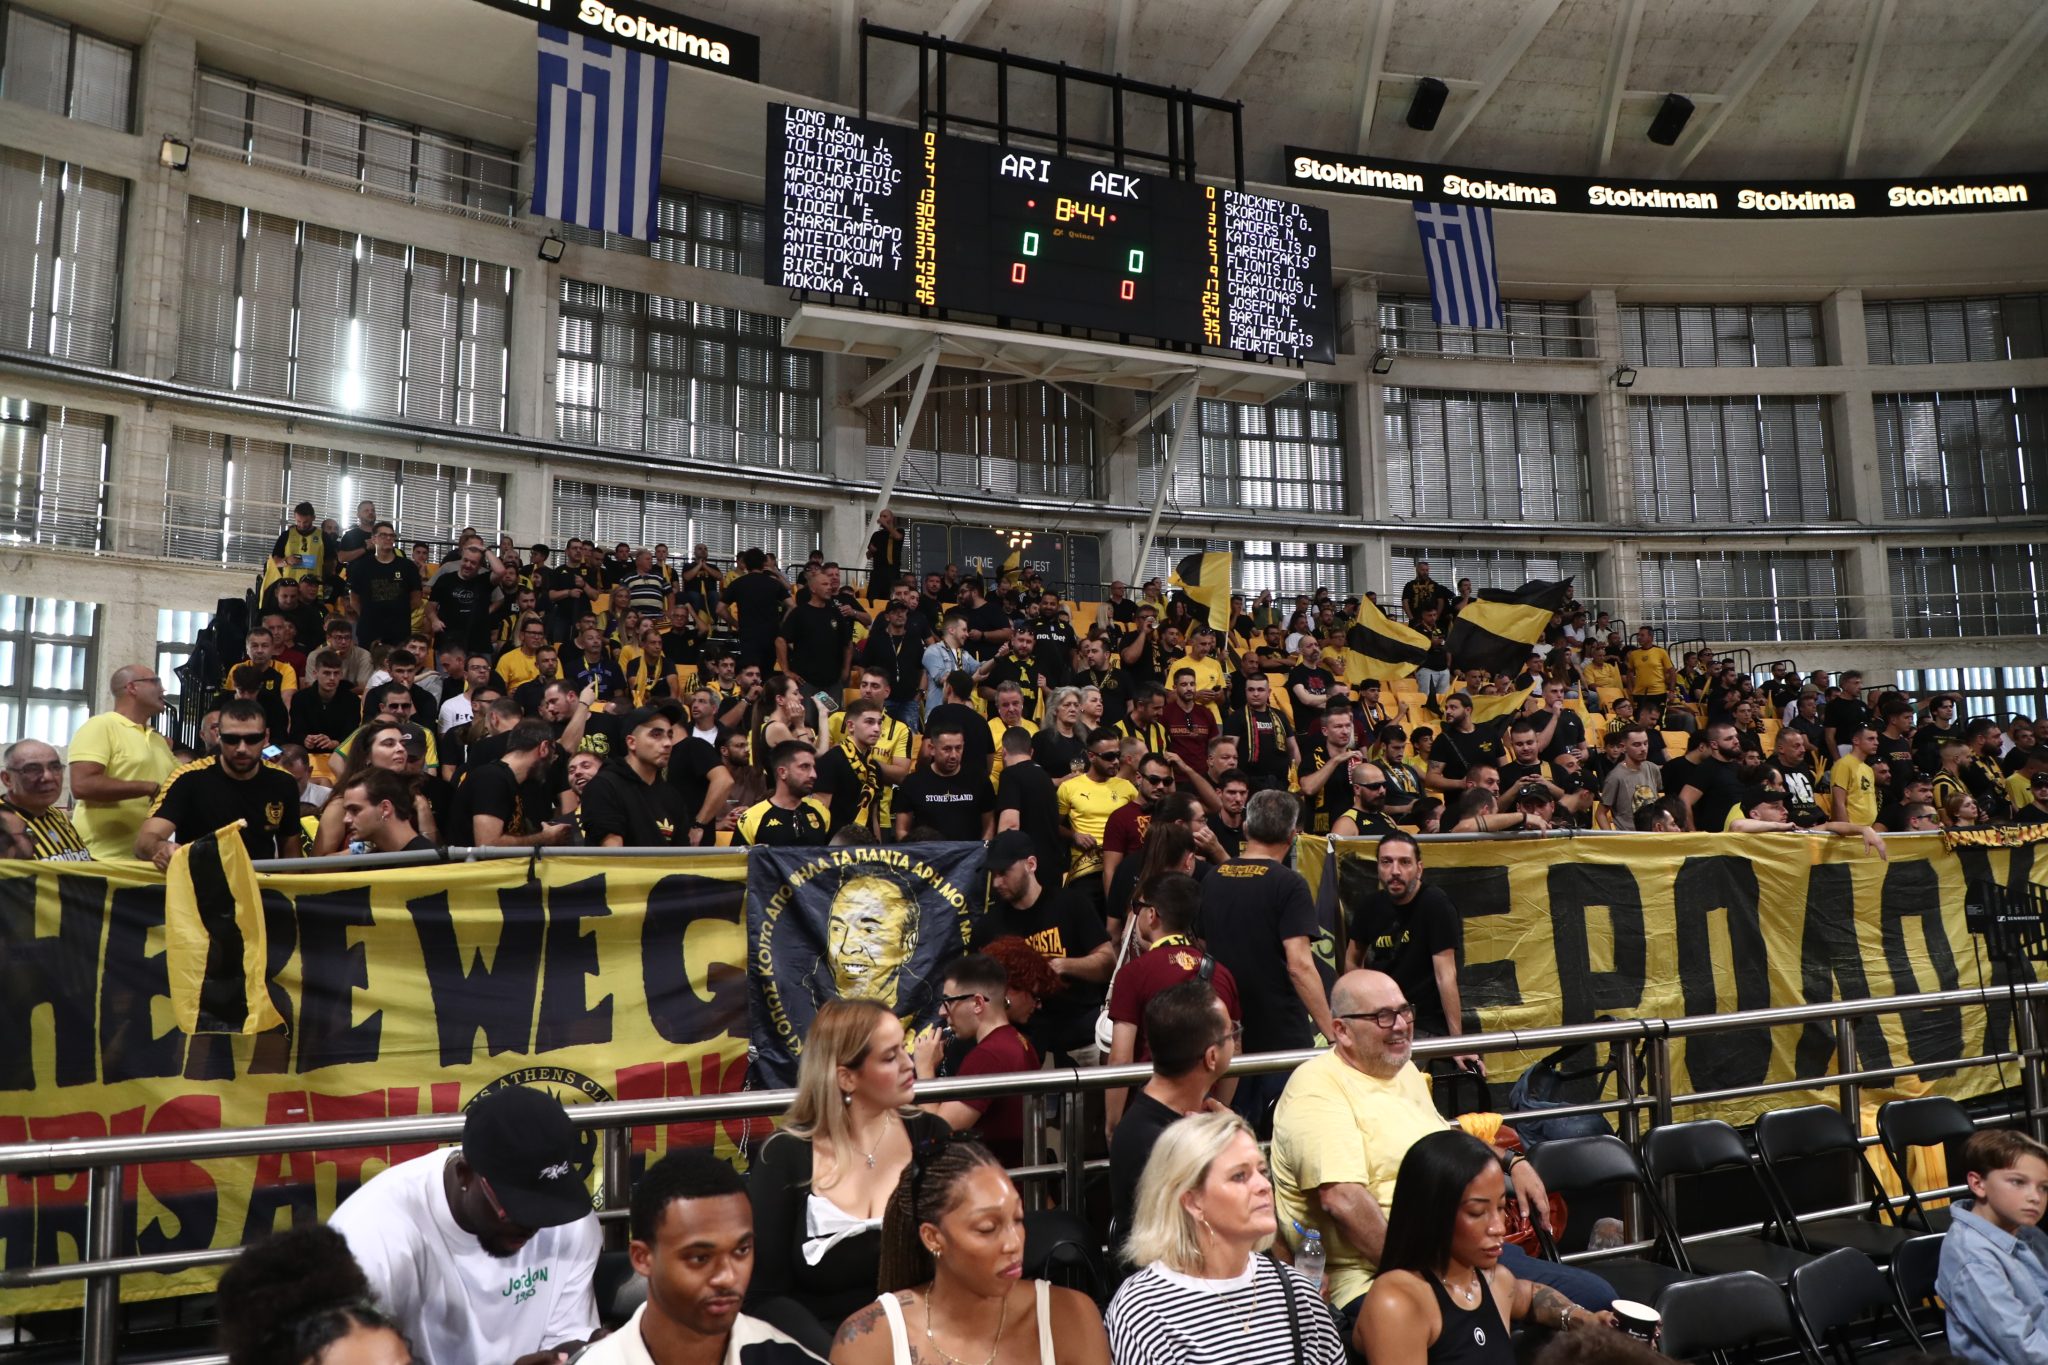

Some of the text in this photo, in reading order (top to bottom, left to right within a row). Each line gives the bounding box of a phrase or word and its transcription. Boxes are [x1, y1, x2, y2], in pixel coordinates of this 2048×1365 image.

[578, 0, 730, 65] Stoixima
[785, 107, 935, 146] LONG M. 0
[785, 122, 935, 160] ROBINSON J. 3
[784, 151, 935, 187] DIMITRIJEVIC 7
[787, 136, 935, 173] TOLIOPOULOS 4
[1001, 154, 1051, 183] ARI
[784, 167, 935, 202] MPOCHORIDIS 13
[1090, 171, 1141, 199] AEK
[1294, 157, 2027, 210] Stoiximan Stoixima Stoiximan Stoixima Stoiximan
[784, 181, 935, 217] MORGAN M. 30
[1056, 198, 1105, 227] 8:44
[1206, 187, 1304, 217] 0 PINCKNEY D.
[784, 197, 935, 232] LIDDELL E. 32
[784, 211, 935, 247] CHARALAMPOPO 33
[1208, 214, 1299, 241] 3 LANDERS N.
[1211, 202, 1312, 231] 1 SKORDILIS G.
[784, 227, 935, 260] ANTETOKOUM K 37
[1023, 232, 1039, 256] 0
[1208, 227, 1316, 257] 4 KATSIVELIS D
[1209, 240, 1309, 269] 5 LARENTZAKIS
[783, 257, 935, 290] BIRCH K. 92
[784, 242, 935, 276] ANTETOKOUM T 43
[1012, 263, 1026, 283] 0
[1129, 250, 1144, 273] 0
[1210, 253, 1300, 279] 7 FLIONIS D.
[783, 272, 935, 305] MOKOKA A. 95
[1121, 280, 1134, 299] 0
[1207, 279, 1219, 292] 17
[1229, 283, 1296, 305] CHARTONAS
[1210, 266, 1317, 296] 9 LEKAVICIUS L
[1202, 291, 1294, 318] 23 JOSEPH N.
[1203, 304, 1302, 333] 24 BARTLEY F.
[1204, 319, 1313, 347] 35 TSALMPOURIS
[1205, 332, 1303, 359] 77 HEURTEL T.
[965, 555, 1050, 572] HOME GUEST
[1036, 632, 1066, 642] novbet
[925, 793, 973, 802] STONE ISLAND
[766, 885, 793, 921] ΑΠΟ
[830, 851, 853, 866] ΤΑ
[855, 848, 910, 868] ΠΑΝΤΑ
[912, 862, 943, 889] ΑΡΗ
[938, 884, 969, 915] ΜΟΥ
[407, 873, 613, 1067] WE
[500, 1068, 575, 1089] ATHENS
